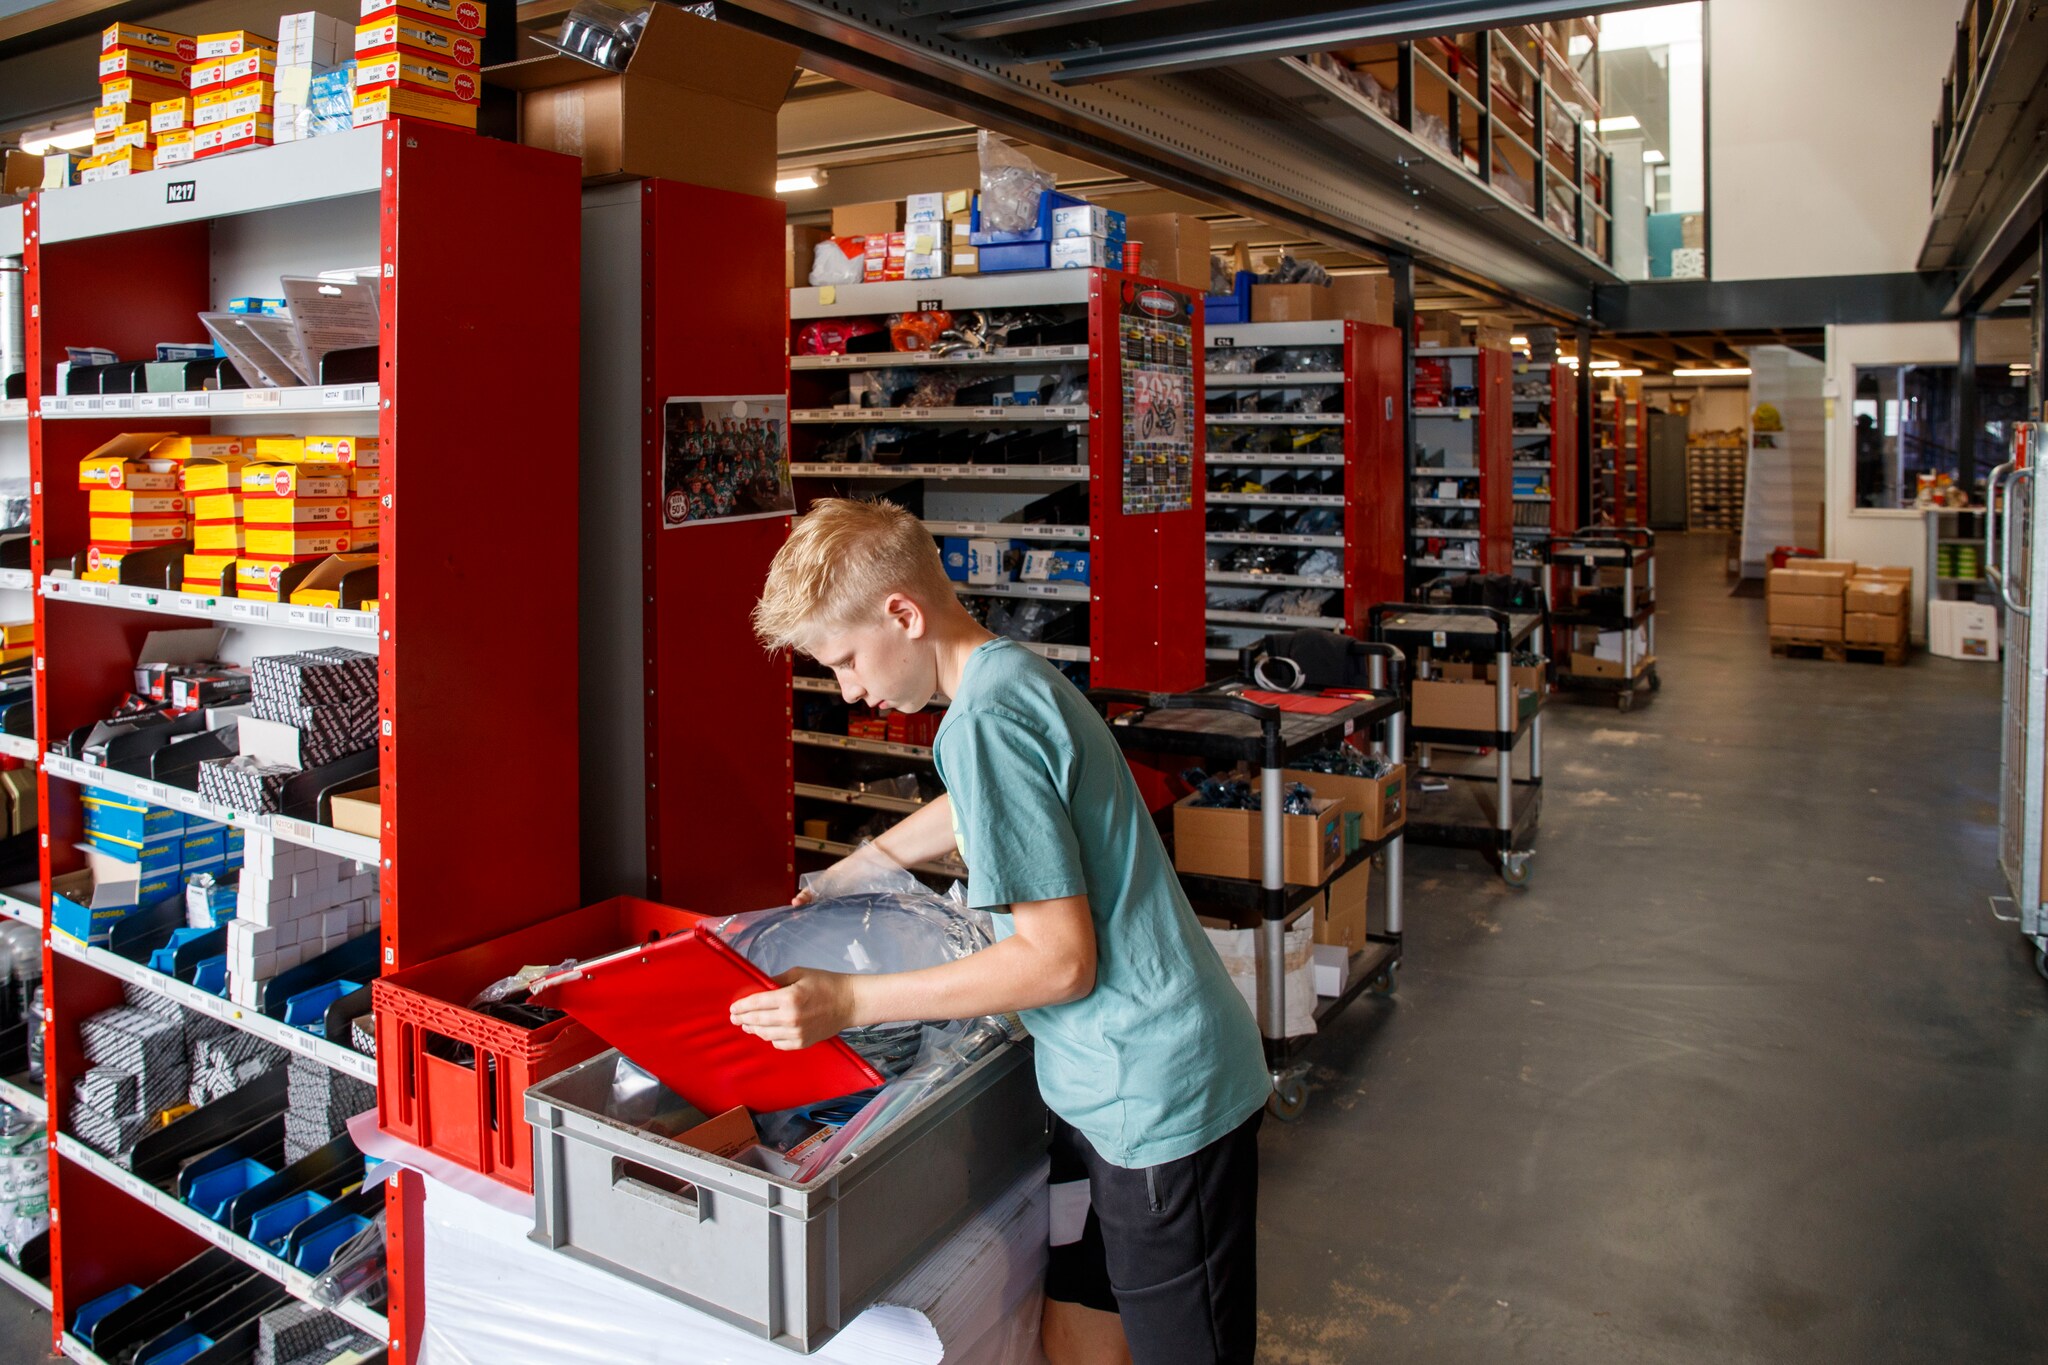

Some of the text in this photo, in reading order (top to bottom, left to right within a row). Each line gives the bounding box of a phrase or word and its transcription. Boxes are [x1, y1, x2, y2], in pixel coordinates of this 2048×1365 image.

[460, 8, 476, 18] NGK
[179, 43, 195, 52] NGK
[456, 45, 472, 54] NGK
[457, 79, 472, 89] NGK
[168, 184, 194, 202] N217
[1055, 212, 1069, 223] CP
[385, 264, 393, 275] A
[921, 301, 938, 311] B12
[1137, 376, 1183, 407] 2025
[384, 722, 391, 733] C
[386, 950, 392, 961] D
[787, 1128, 832, 1158] DEESTONE
